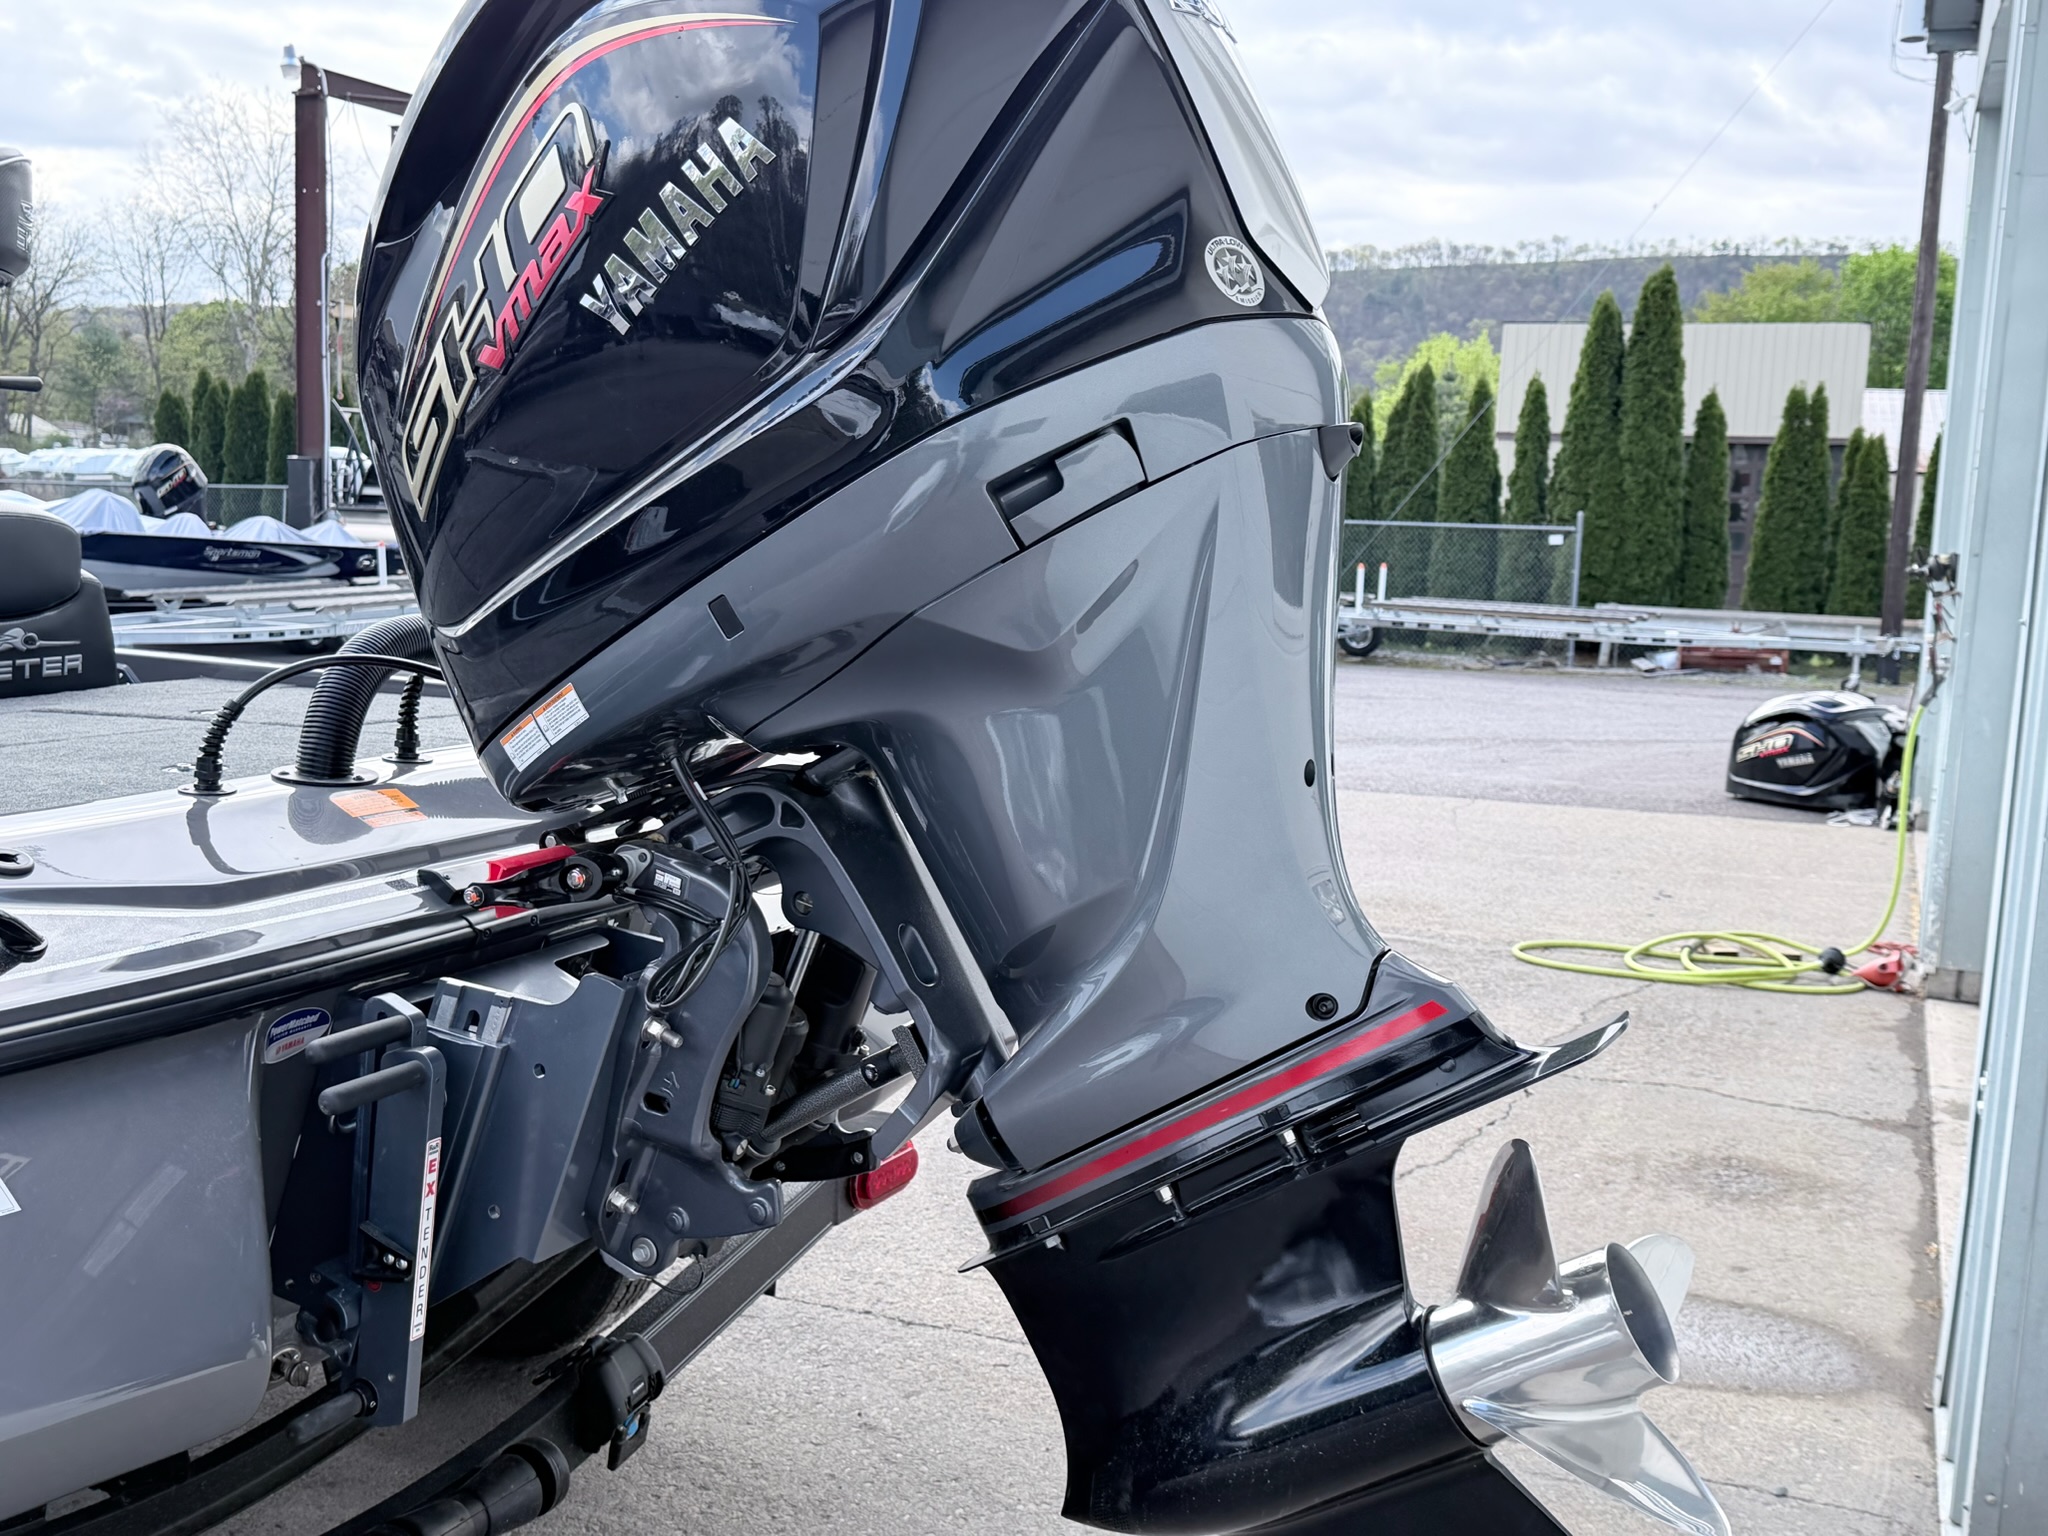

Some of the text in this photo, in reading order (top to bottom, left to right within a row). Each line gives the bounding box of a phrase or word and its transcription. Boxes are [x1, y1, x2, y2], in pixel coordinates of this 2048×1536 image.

[579, 116, 777, 335] YAMAHA
[1775, 751, 1816, 769] YAMAHA
[416, 1157, 438, 1318] EXTENDER
